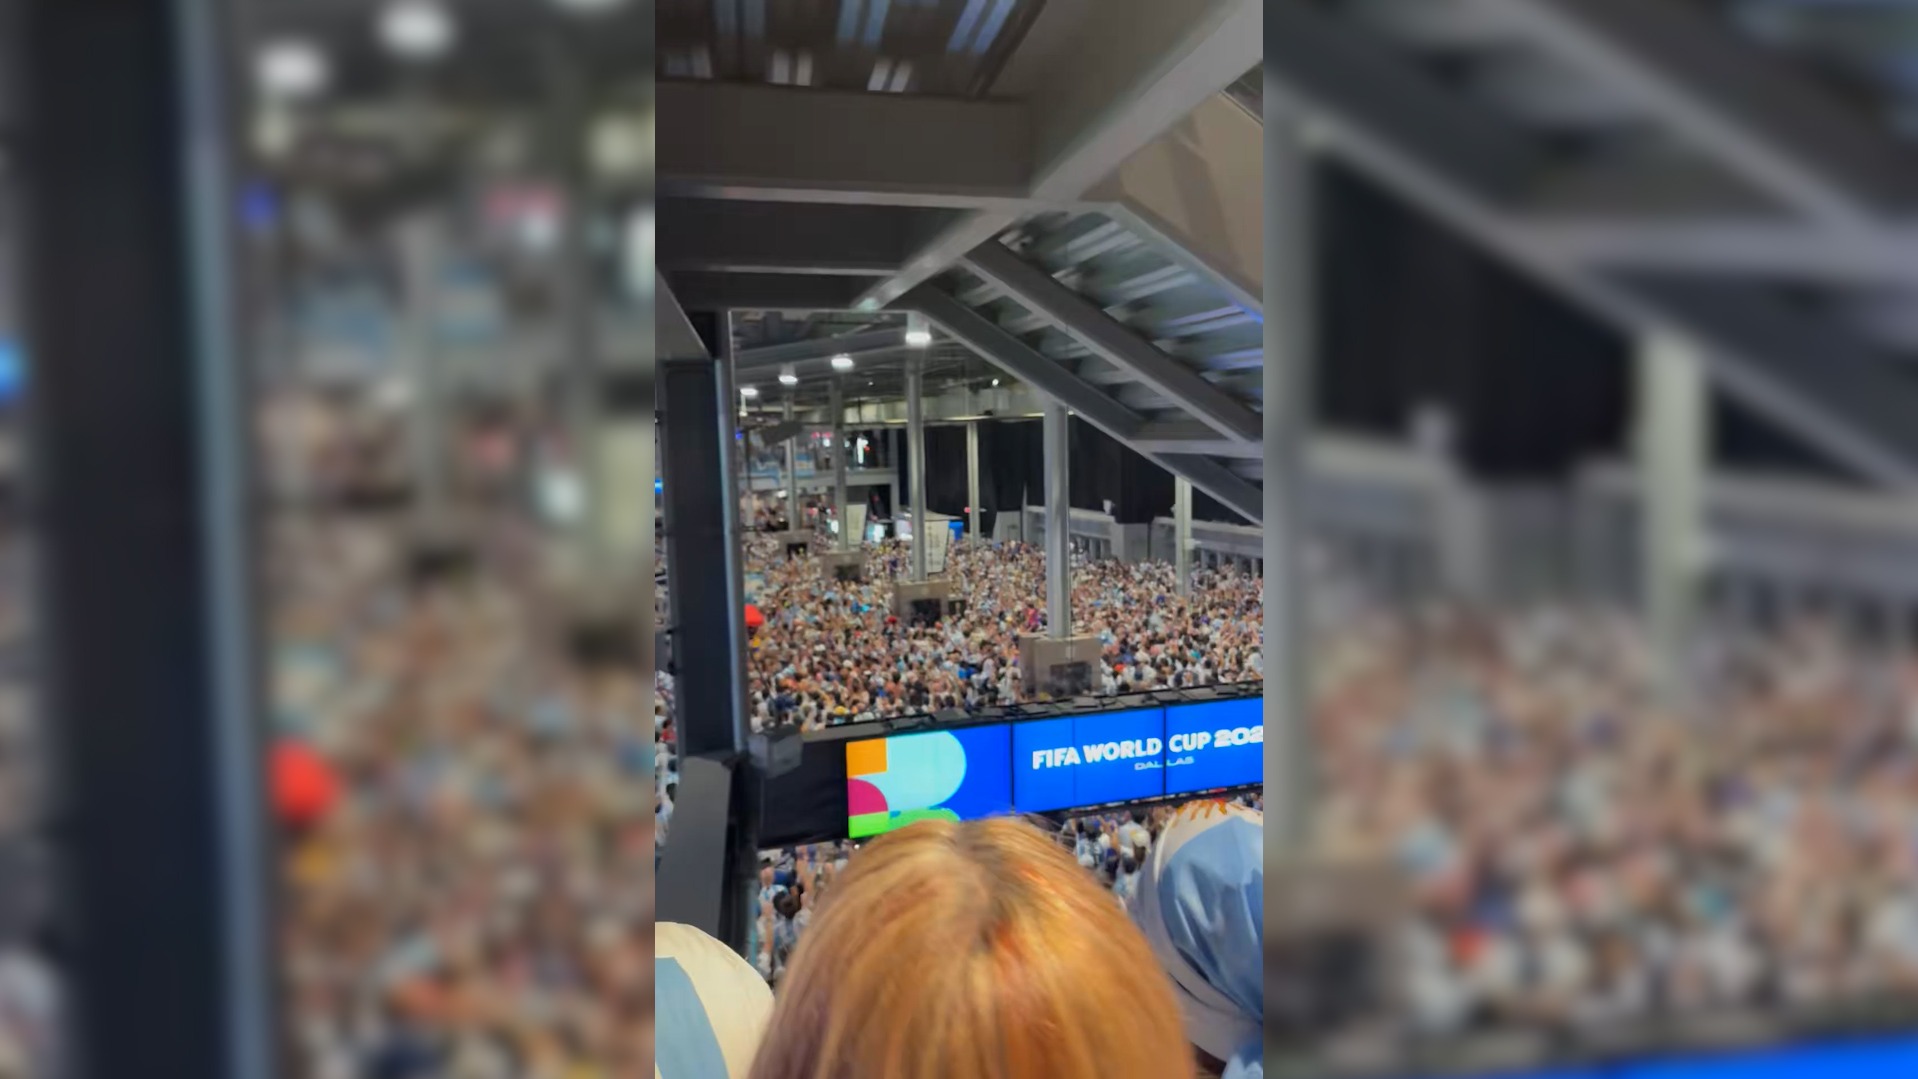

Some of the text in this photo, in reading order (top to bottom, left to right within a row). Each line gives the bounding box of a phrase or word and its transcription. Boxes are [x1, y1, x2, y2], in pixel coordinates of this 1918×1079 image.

[1032, 746, 1081, 770] FIFA
[1082, 737, 1163, 763] WORLD
[1168, 731, 1212, 753] CUP
[1134, 755, 1195, 771] DALLAS
